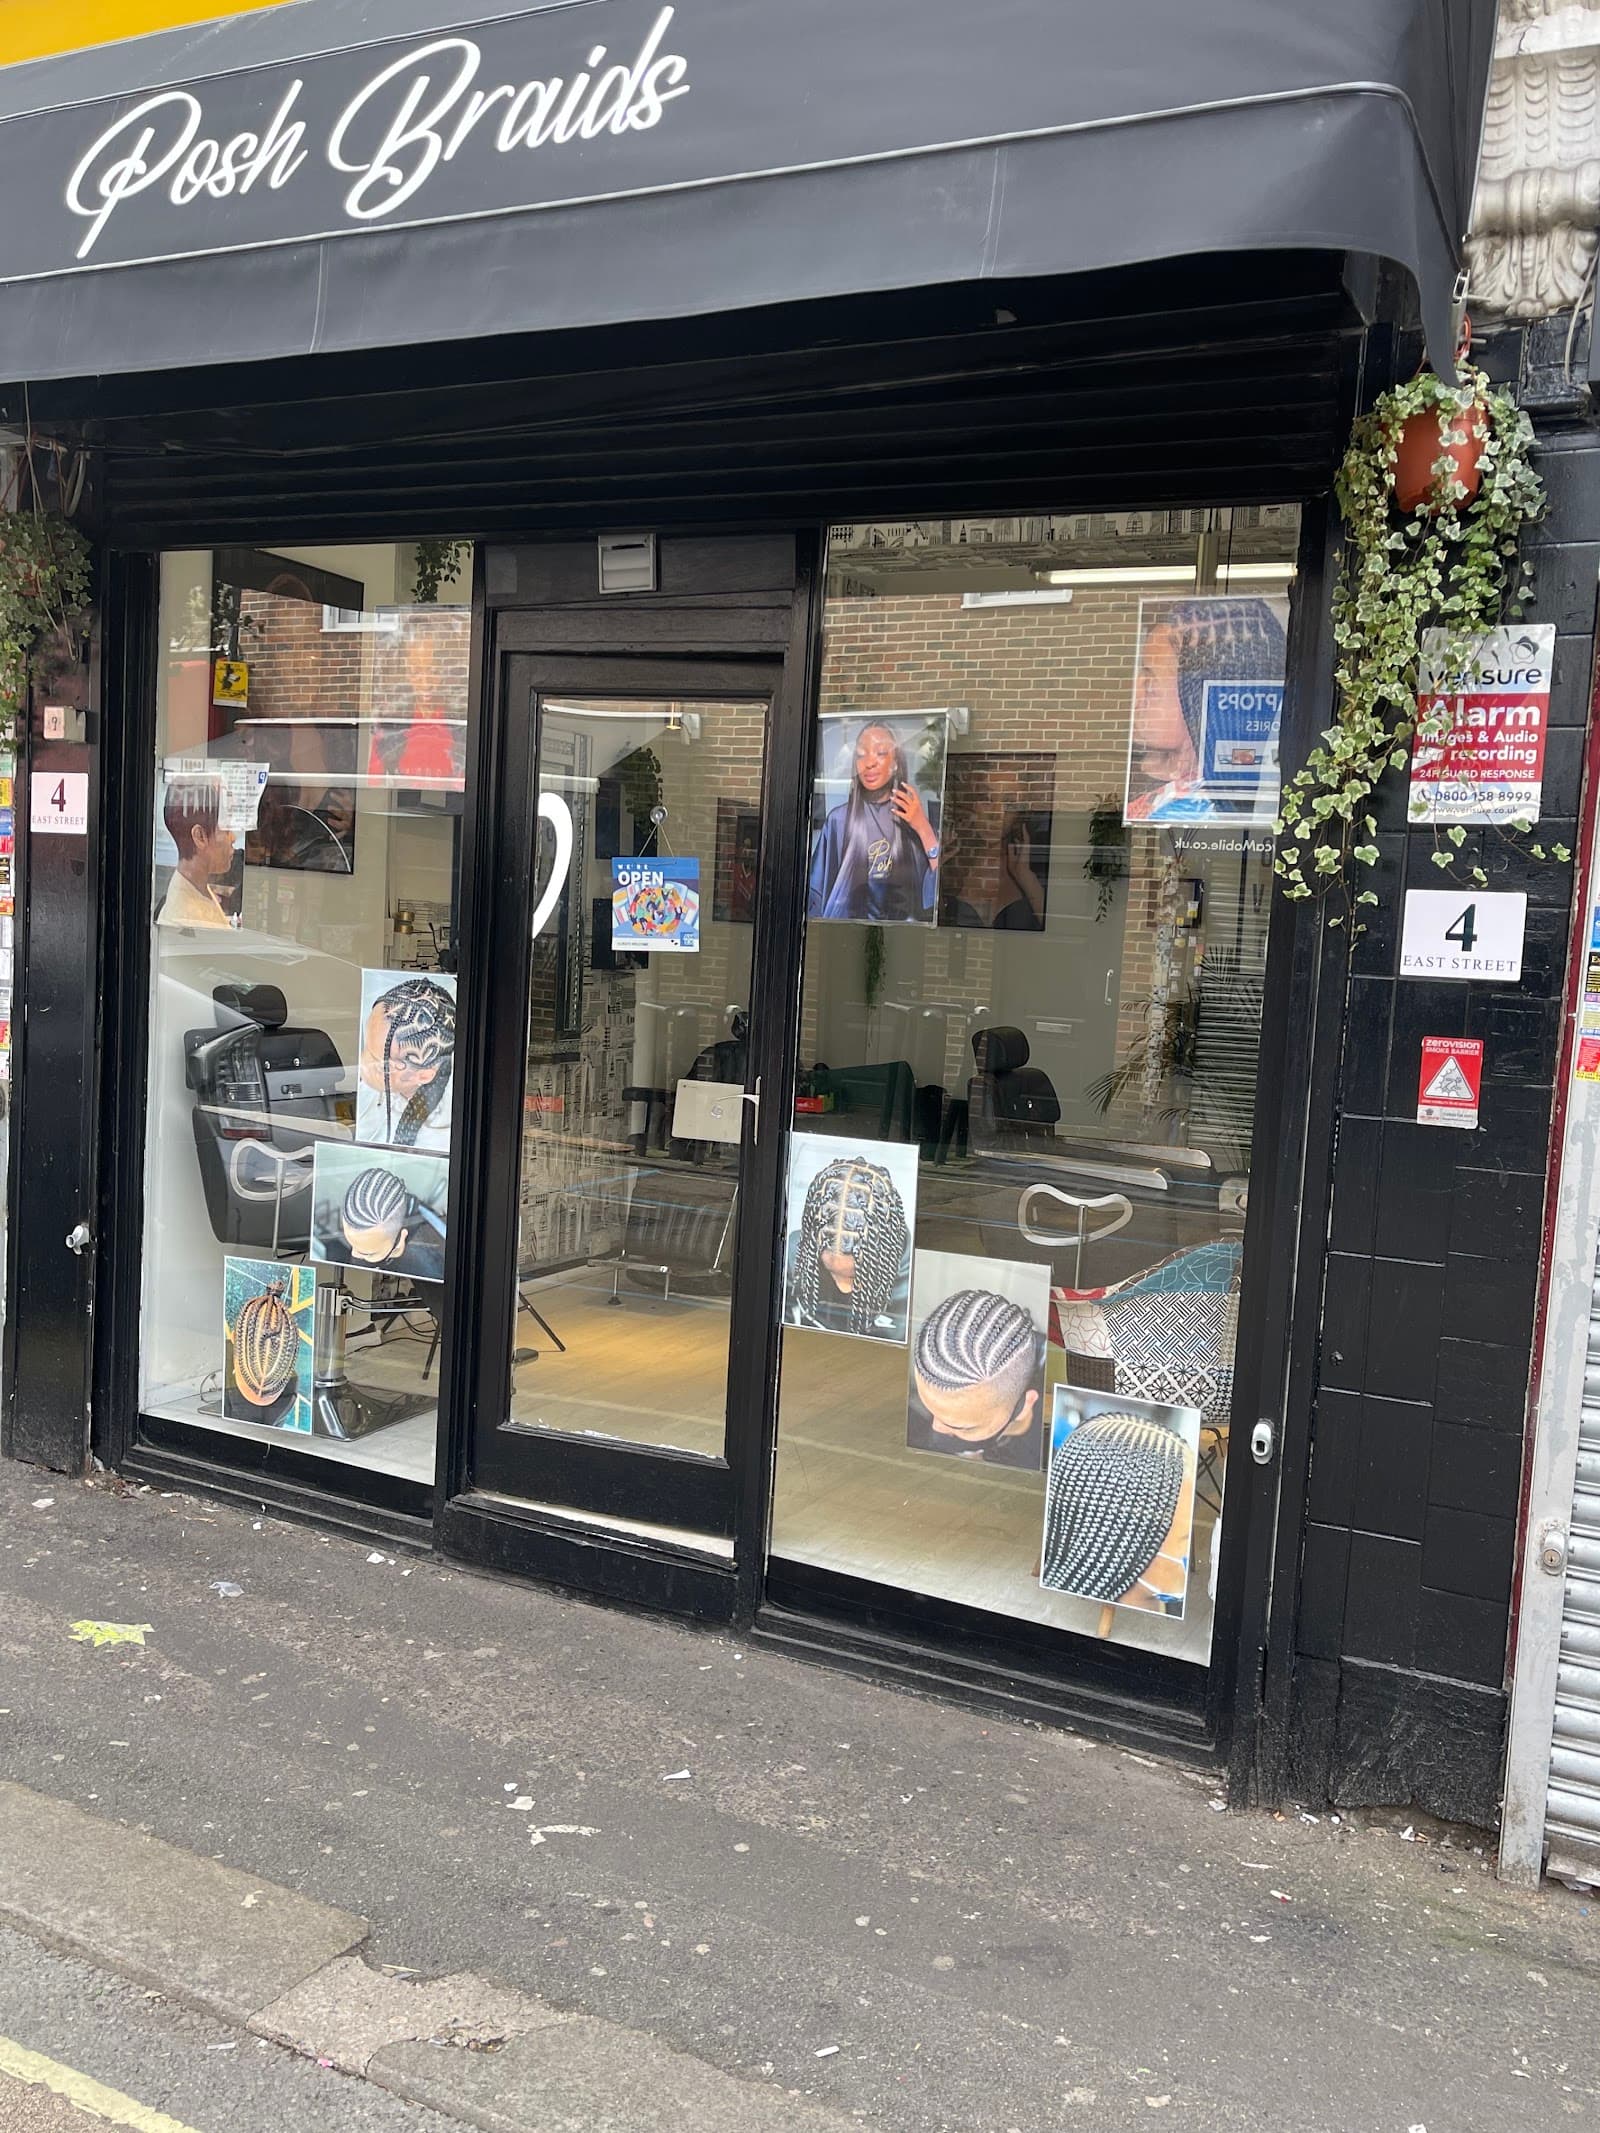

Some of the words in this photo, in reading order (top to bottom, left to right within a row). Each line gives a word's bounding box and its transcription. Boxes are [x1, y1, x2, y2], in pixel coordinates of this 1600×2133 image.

[66, 79, 308, 258] Posh
[328, 5, 691, 219] Braids
[1477, 730, 1491, 743] &
[1493, 730, 1539, 743] Audio
[1450, 745, 1538, 764] recording
[1480, 769, 1535, 779] RESPONSE
[51, 778, 66, 812] 4
[1435, 790, 1467, 802] 0800
[1473, 790, 1494, 802] 158
[1498, 791, 1532, 802] 8999
[32, 815, 52, 824] EAST
[54, 815, 84, 825] STREET
[617, 871, 664, 886] OPEN
[1445, 904, 1477, 952] 4
[1403, 955, 1446, 969] EAST
[1451, 957, 1517, 972] STREET
[1425, 1039, 1480, 1050] zerovision
[1425, 1047, 1449, 1055] SMOKE
